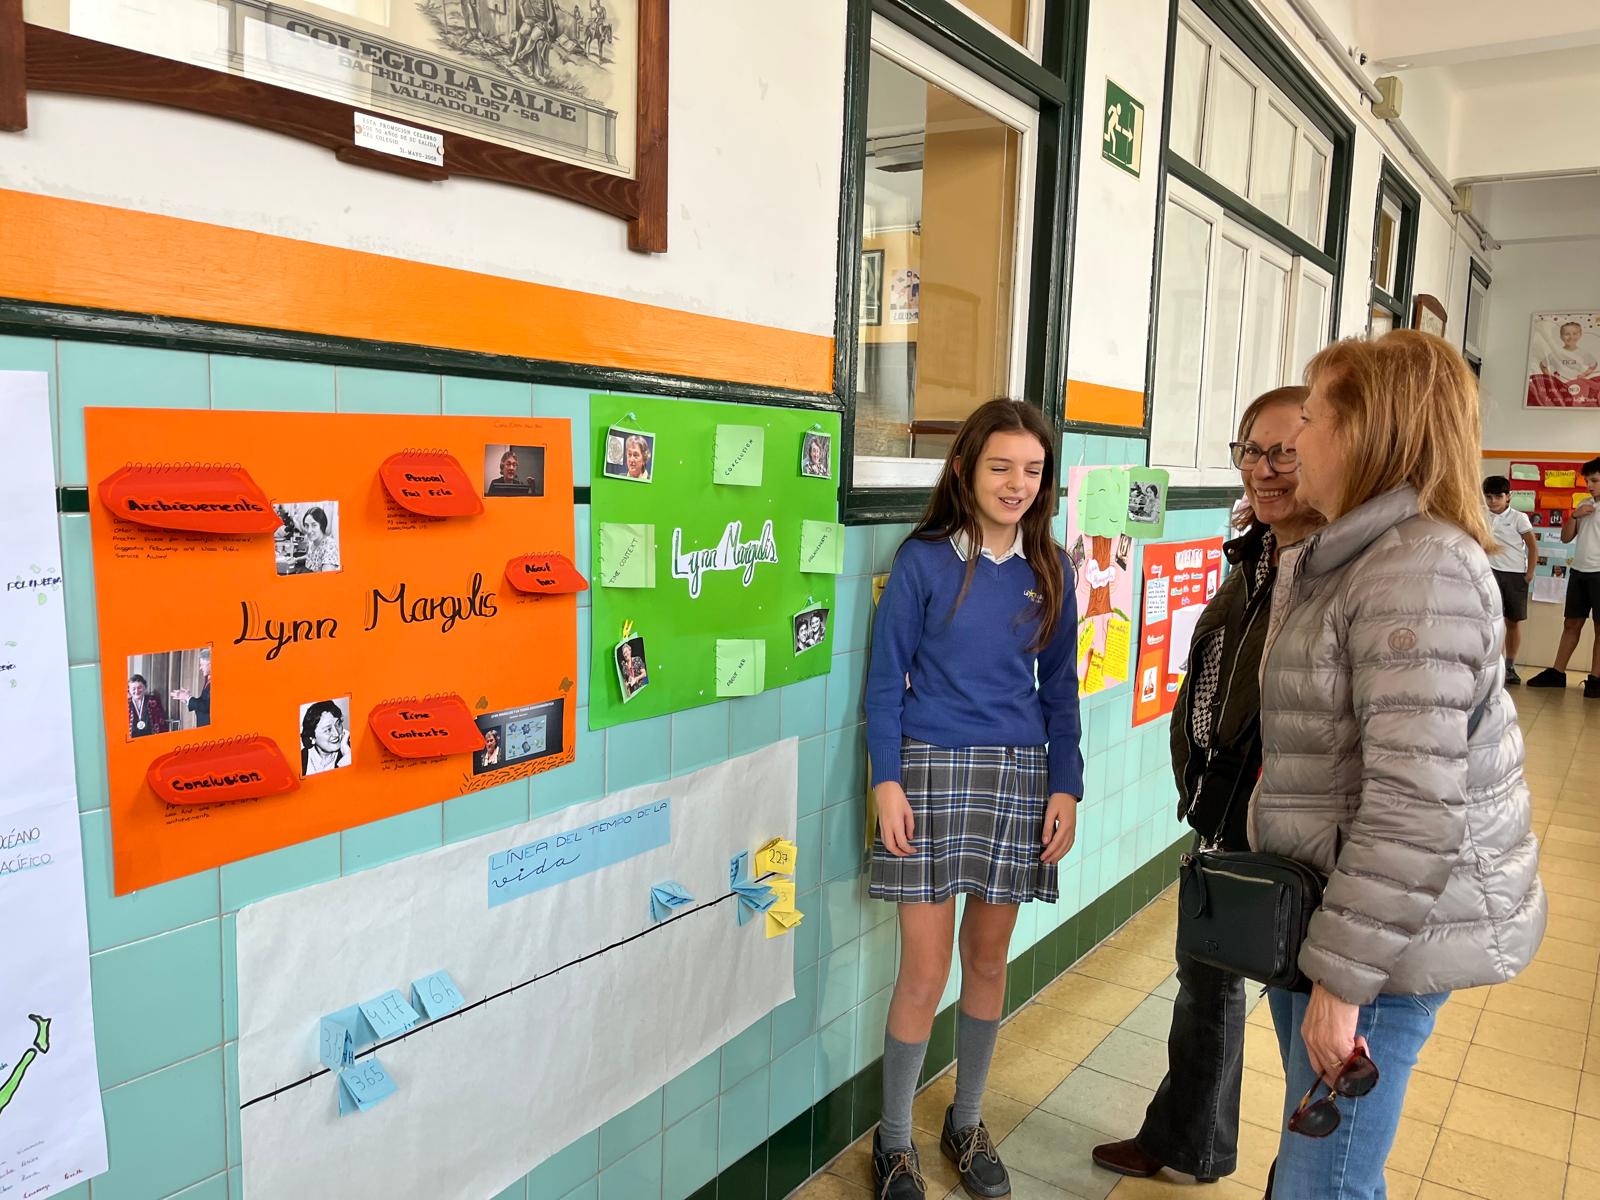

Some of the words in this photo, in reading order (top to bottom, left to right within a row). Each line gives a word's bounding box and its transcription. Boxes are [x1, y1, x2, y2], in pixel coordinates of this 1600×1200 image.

[286, 21, 439, 80] COLEGIO
[444, 68, 484, 95] LA
[490, 81, 577, 122] SALLE
[339, 55, 467, 101] BACHILLERES
[389, 83, 501, 122] VALLADOLID
[674, 530, 718, 596] Lynn
[724, 522, 778, 585] Margulis
[233, 601, 338, 661] Lynn
[364, 572, 498, 633] Margulis
[0, 853, 52, 875] ACÍFICO
[491, 842, 549, 871] LÍNEA
[556, 833, 582, 848] DEL
[653, 802, 668, 813] LA
[491, 853, 581, 889] vida
